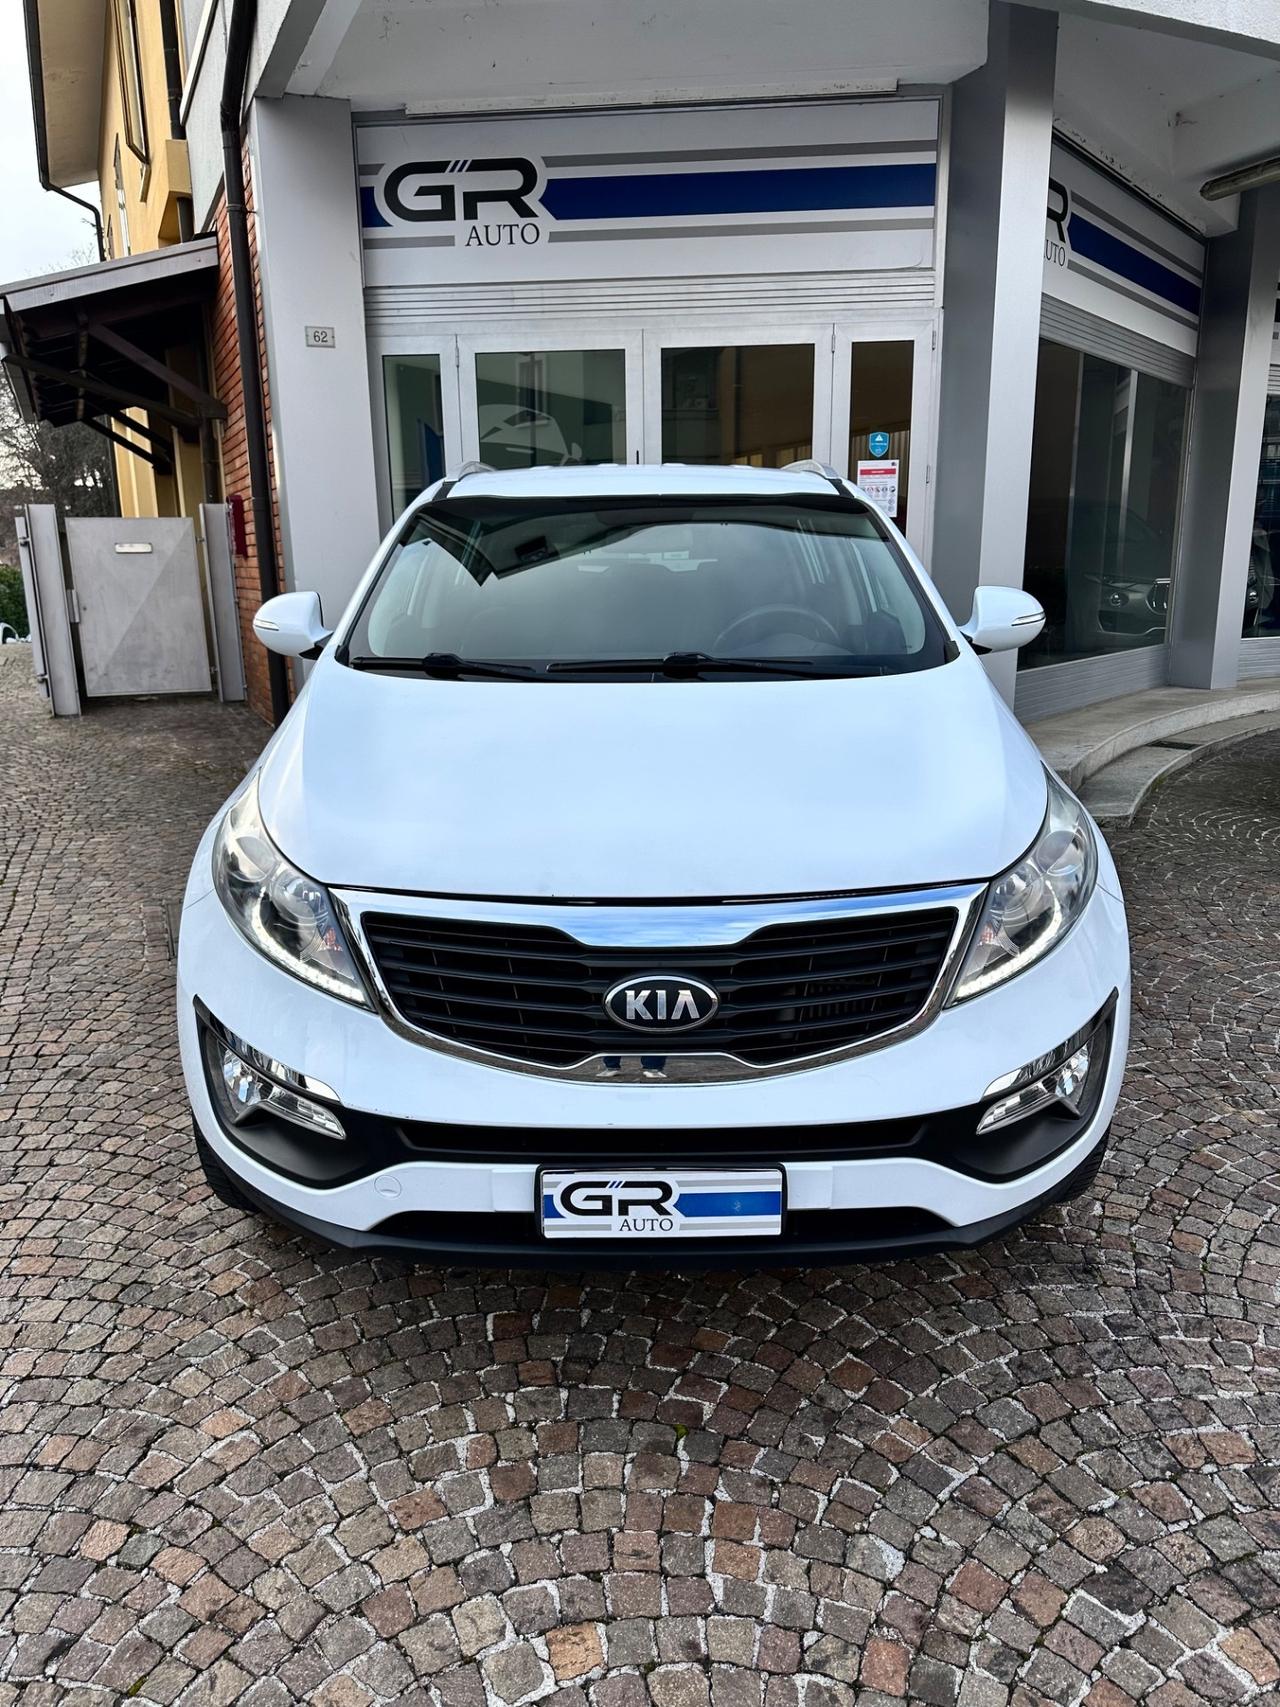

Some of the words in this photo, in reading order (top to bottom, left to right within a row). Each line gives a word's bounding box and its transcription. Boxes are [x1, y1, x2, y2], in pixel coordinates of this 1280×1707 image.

[384, 157, 539, 222] GR
[1046, 176, 1068, 244] R
[465, 222, 540, 247] AUTO
[1044, 239, 1066, 267] UTO
[313, 330, 328, 343] 62
[625, 989, 700, 1020] KIA
[560, 1180, 674, 1217] GR
[619, 1218, 674, 1232] AUTO
